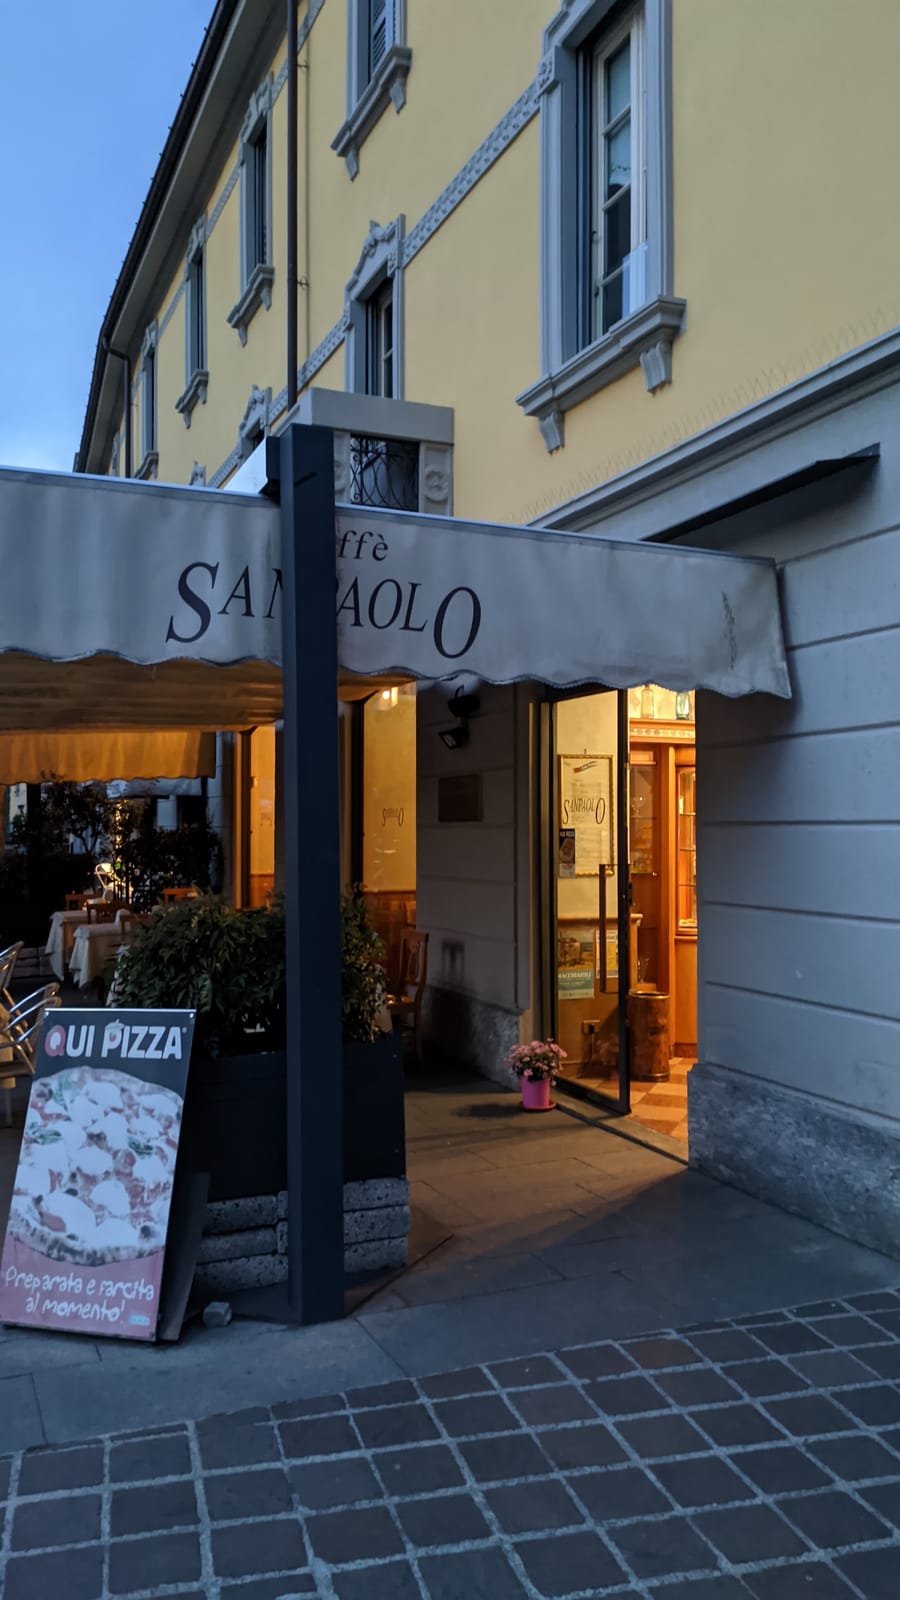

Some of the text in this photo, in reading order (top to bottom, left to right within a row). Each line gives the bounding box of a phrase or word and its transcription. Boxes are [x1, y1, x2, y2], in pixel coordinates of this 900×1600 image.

[337, 529, 389, 562] ffè
[165, 560, 482, 659] SAAOLO
[44, 1023, 183, 1060] QUI PIZZA
[5, 1265, 83, 1294] Preparata
[86, 1279, 96, 1296] e
[25, 1292, 41, 1313] al
[42, 1299, 126, 1324] momento!
